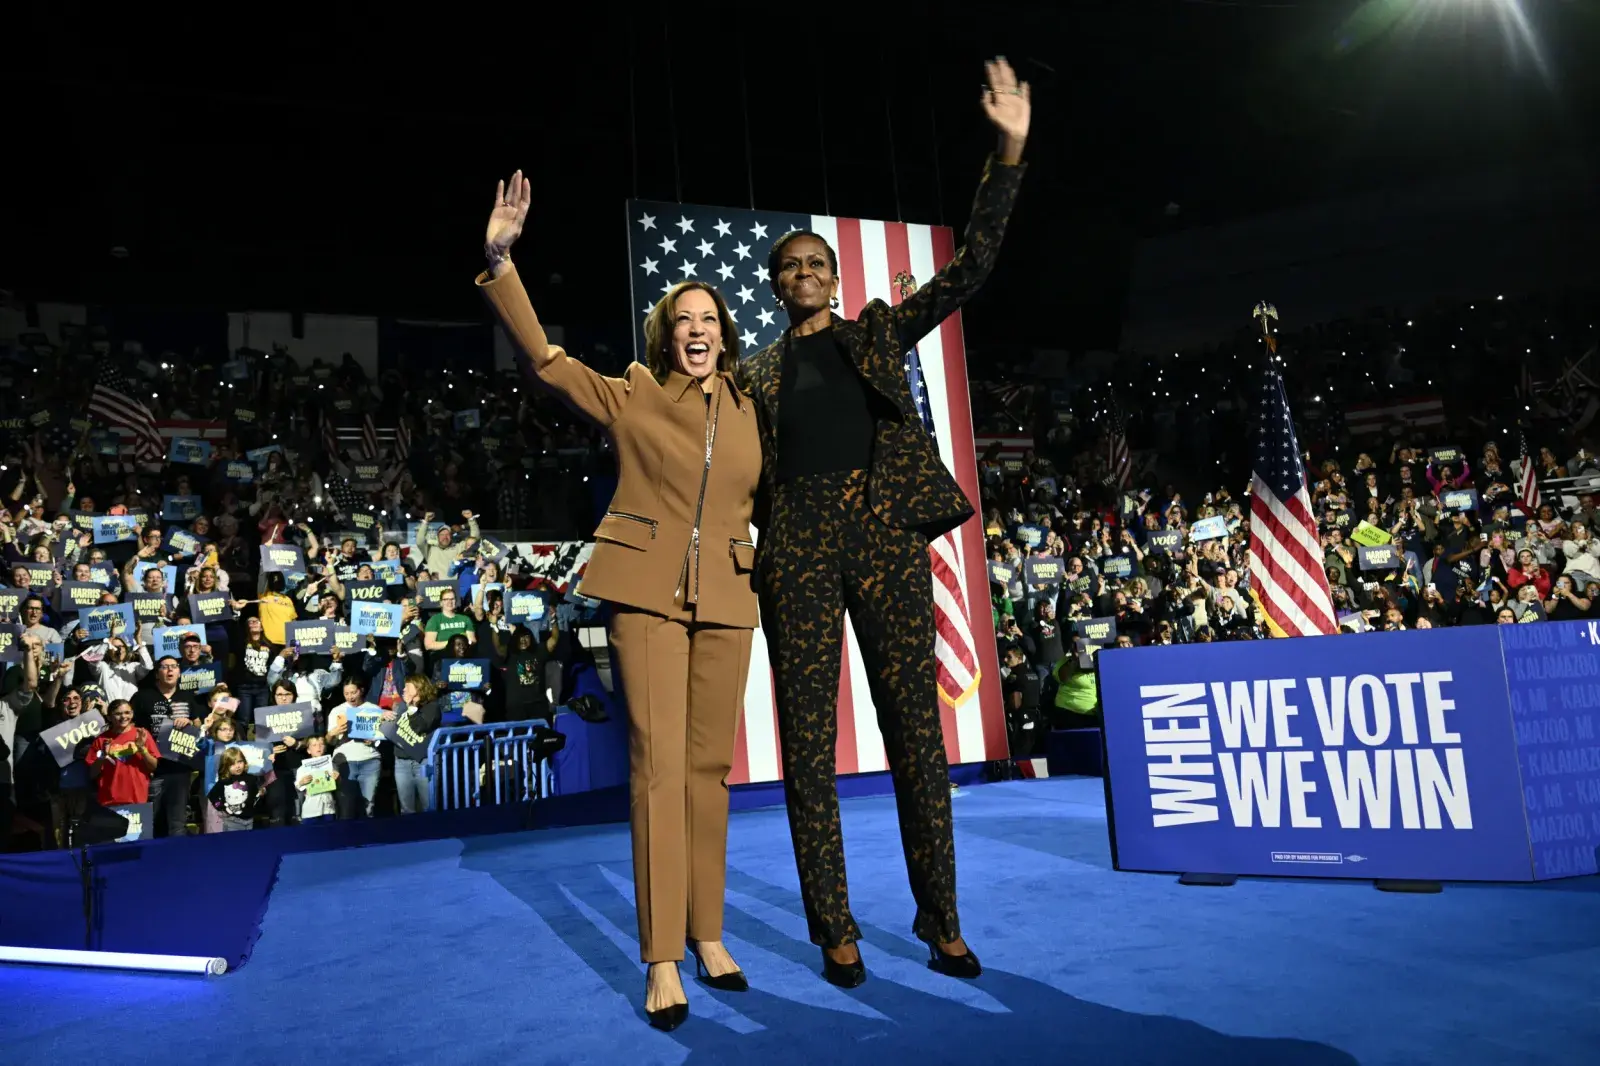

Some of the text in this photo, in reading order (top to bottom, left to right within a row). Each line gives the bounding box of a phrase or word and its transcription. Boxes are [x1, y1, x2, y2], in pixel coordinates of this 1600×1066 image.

[1151, 534, 1178, 546] vote
[1032, 563, 1058, 573] HARRIS
[71, 588, 101, 599] HARRIS
[351, 585, 384, 600] vote
[75, 598, 96, 606] WALZ
[198, 598, 225, 611] HARRIS
[88, 611, 124, 625] MICHIGAN
[203, 607, 222, 617] WALZ
[361, 610, 393, 620] MICHIGAN
[88, 621, 108, 632] VOTES
[359, 618, 376, 627] VOTES
[1085, 623, 1110, 634] HARRIS
[294, 627, 328, 640] HARRIS
[300, 637, 324, 647] WALZ
[1211, 671, 1462, 748] WE VOTE
[266, 711, 303, 728] HARRIS
[55, 719, 101, 750] vote
[272, 723, 298, 735] WALZ
[170, 743, 196, 758] WALZ
[1140, 683, 1219, 828] WHEN
[1218, 748, 1473, 829] WE WIN
